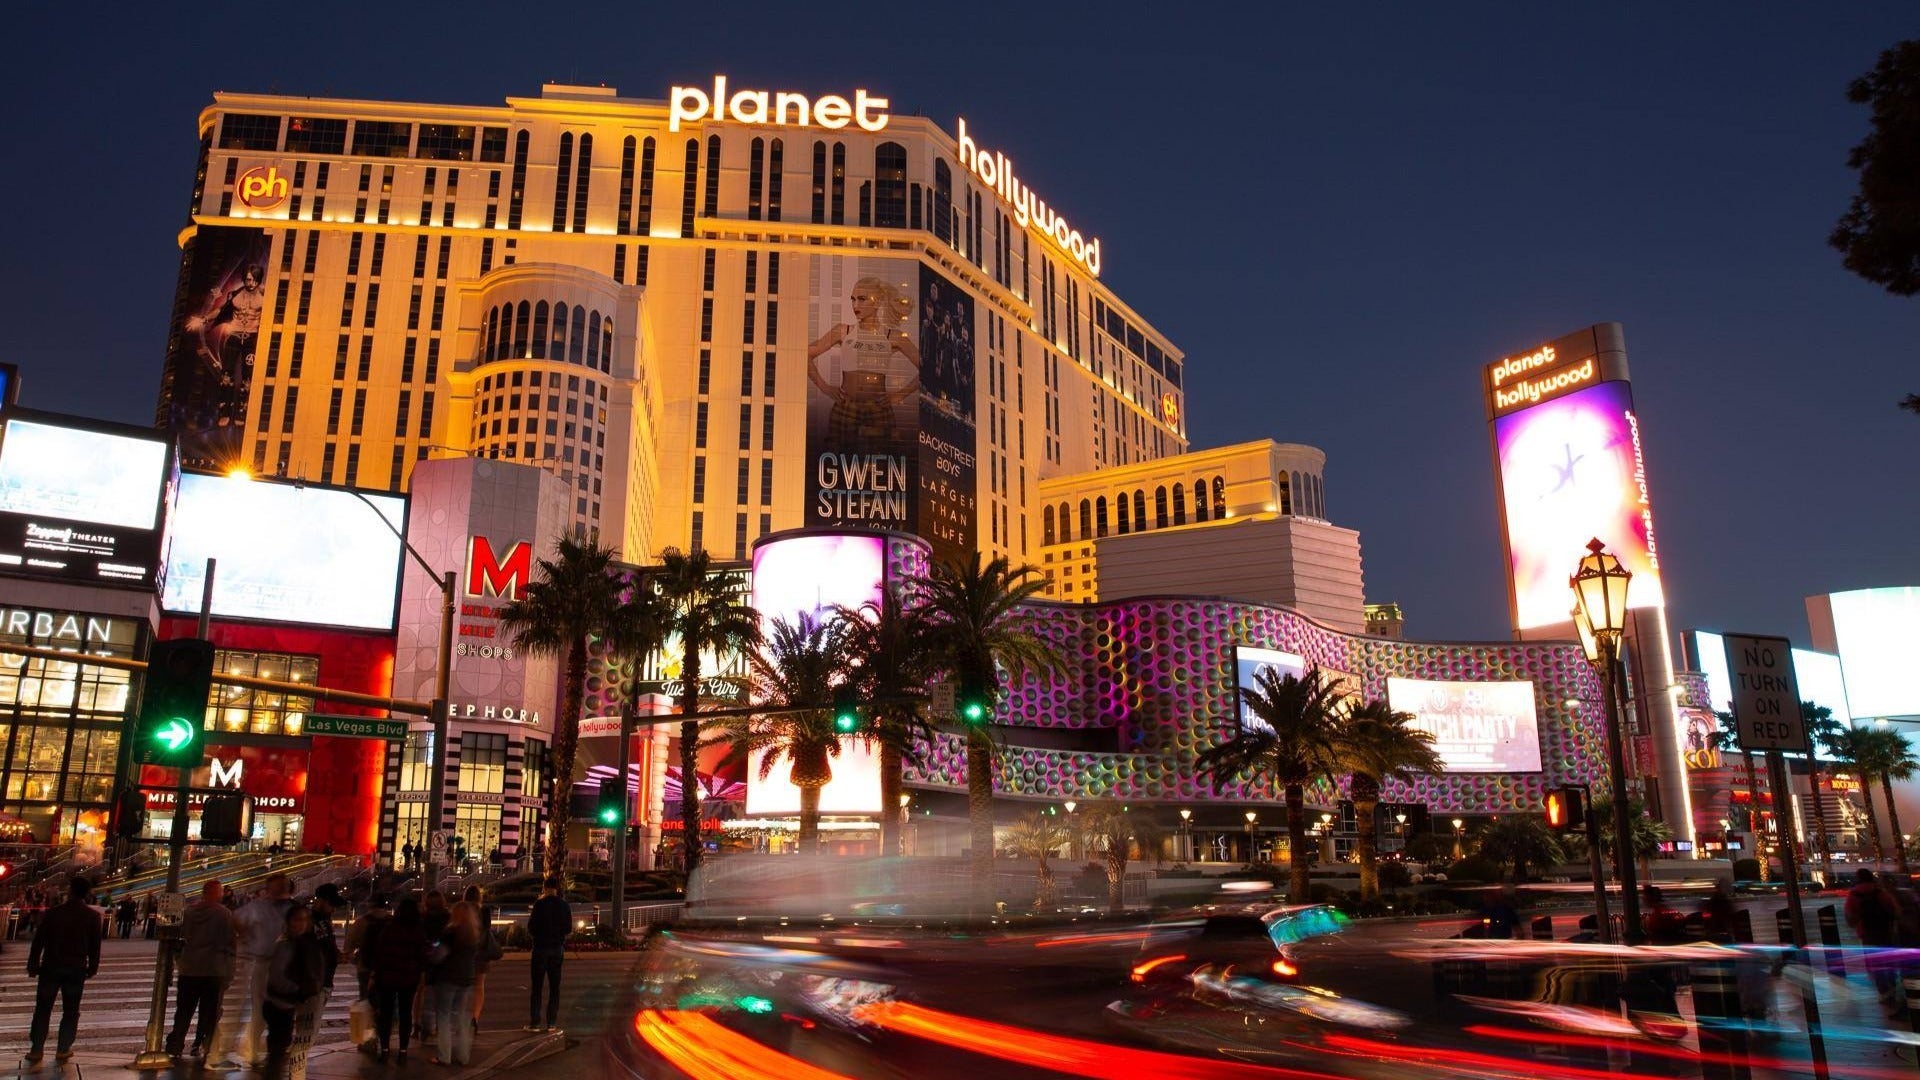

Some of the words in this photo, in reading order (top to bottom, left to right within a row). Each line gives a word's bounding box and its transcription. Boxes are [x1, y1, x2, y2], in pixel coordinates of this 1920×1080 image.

[669, 75, 889, 133] planet
[243, 167, 288, 202] ph
[957, 117, 1101, 277] hollywood
[1494, 346, 1556, 386] planet
[1496, 360, 1594, 409] hollywood
[919, 431, 976, 469] BACKSTREET
[1624, 410, 1650, 505] hollywood
[818, 452, 906, 492] GWEN
[936, 457, 961, 478] BOYS
[817, 488, 907, 521] STEFANI
[921, 475, 975, 511] LARGER
[930, 500, 967, 527] THAN
[72, 532, 115, 544] THEATER
[933, 521, 965, 545] LIFE
[1641, 508, 1660, 570] planet
[463, 535, 532, 601] M
[457, 643, 513, 661] SHOPS
[1744, 648, 1776, 668] NO
[1737, 673, 1790, 692] TURN
[449, 703, 541, 724] EPHORA
[1756, 698, 1781, 716] ON
[308, 718, 332, 731] Las
[335, 720, 373, 735] Vegas
[376, 723, 404, 736] Blvd
[1462, 713, 1518, 740] PARTY
[1753, 722, 1790, 740] RED
[209, 757, 244, 788] M
[148, 793, 210, 804] MIRCLE
